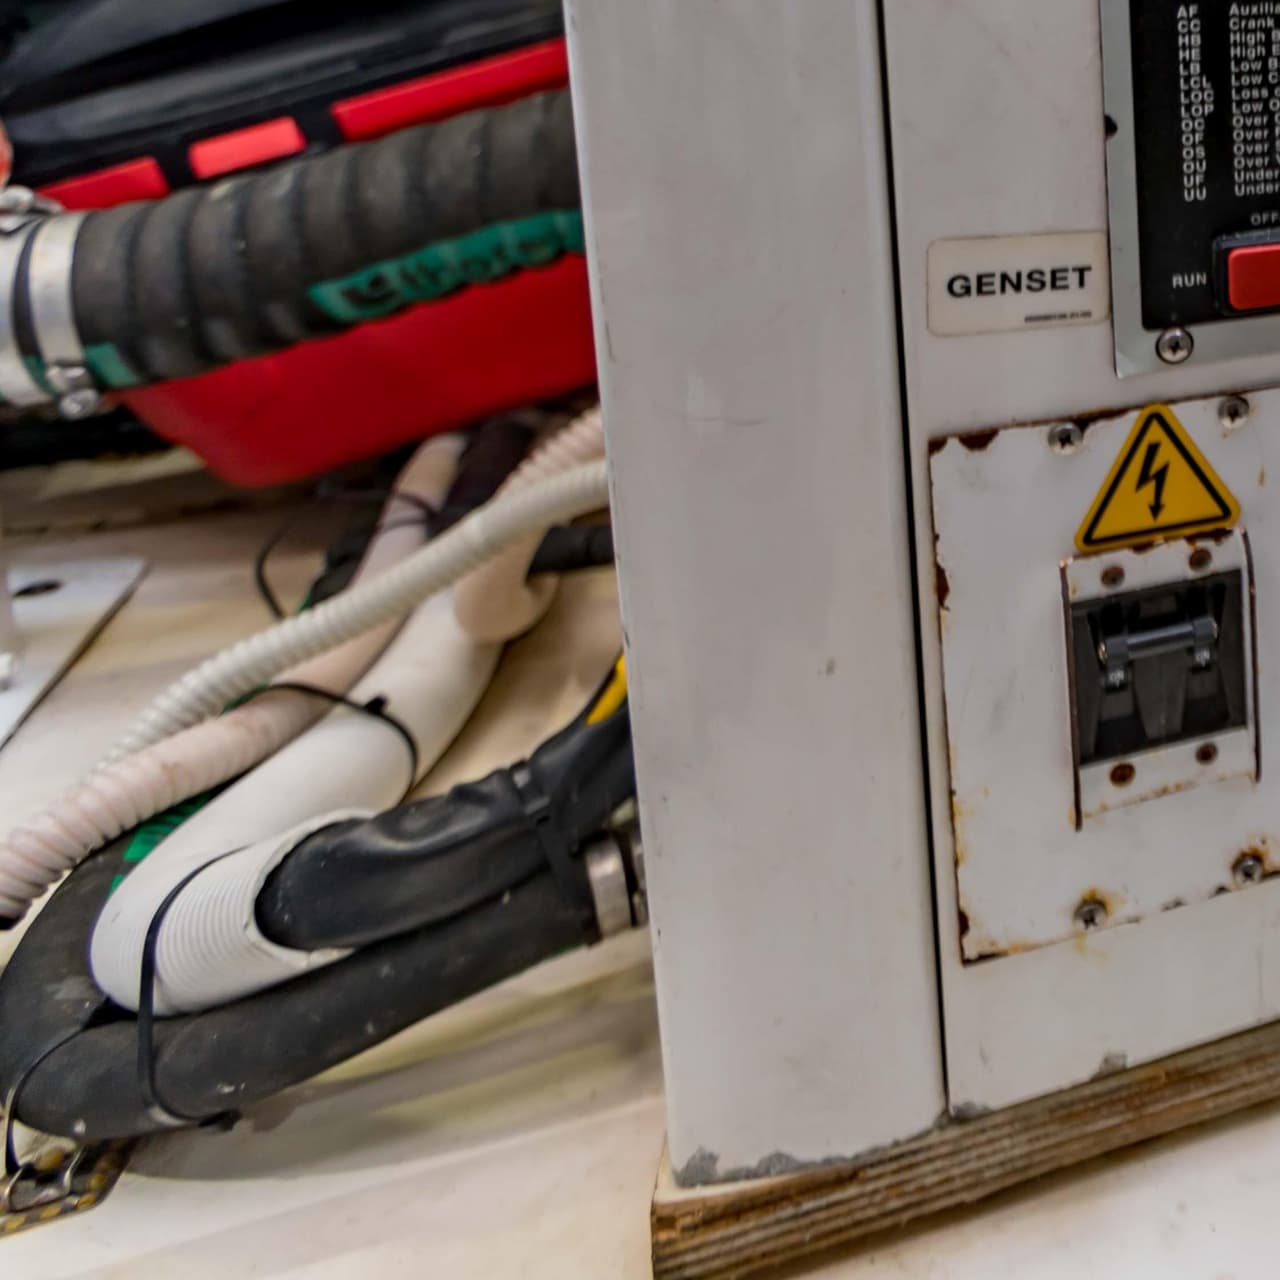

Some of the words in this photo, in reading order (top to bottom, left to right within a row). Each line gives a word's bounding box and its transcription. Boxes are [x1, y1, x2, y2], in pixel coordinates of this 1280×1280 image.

[1177, 4, 1198, 19] AF
[1177, 19, 1201, 33] CC
[1229, 15, 1275, 30] Crank
[1178, 34, 1201, 47] HB
[1229, 29, 1266, 46] High
[1178, 48, 1201, 62] HE
[1230, 43, 1266, 60] High
[1179, 62, 1201, 76] LB
[1230, 60, 1263, 73] Low
[1179, 76, 1212, 90] LCL
[1231, 74, 1263, 87] Low
[1180, 90, 1214, 104] LOC
[1231, 88, 1269, 101] Loss
[1181, 104, 1214, 118] LOP
[1232, 101, 1264, 115] Low
[1181, 118, 1205, 132] OC
[1232, 114, 1269, 128] Over
[1182, 133, 1205, 146] OF
[1233, 129, 1269, 142] Over
[1182, 146, 1205, 160] OS
[1233, 142, 1269, 156] Over
[1234, 156, 1270, 170] Over
[1184, 174, 1205, 188] UF
[1234, 168, 1280, 183] Under
[1235, 182, 1280, 197] Under
[947, 266, 1092, 298] GENSET
[1172, 272, 1207, 288] RUN
